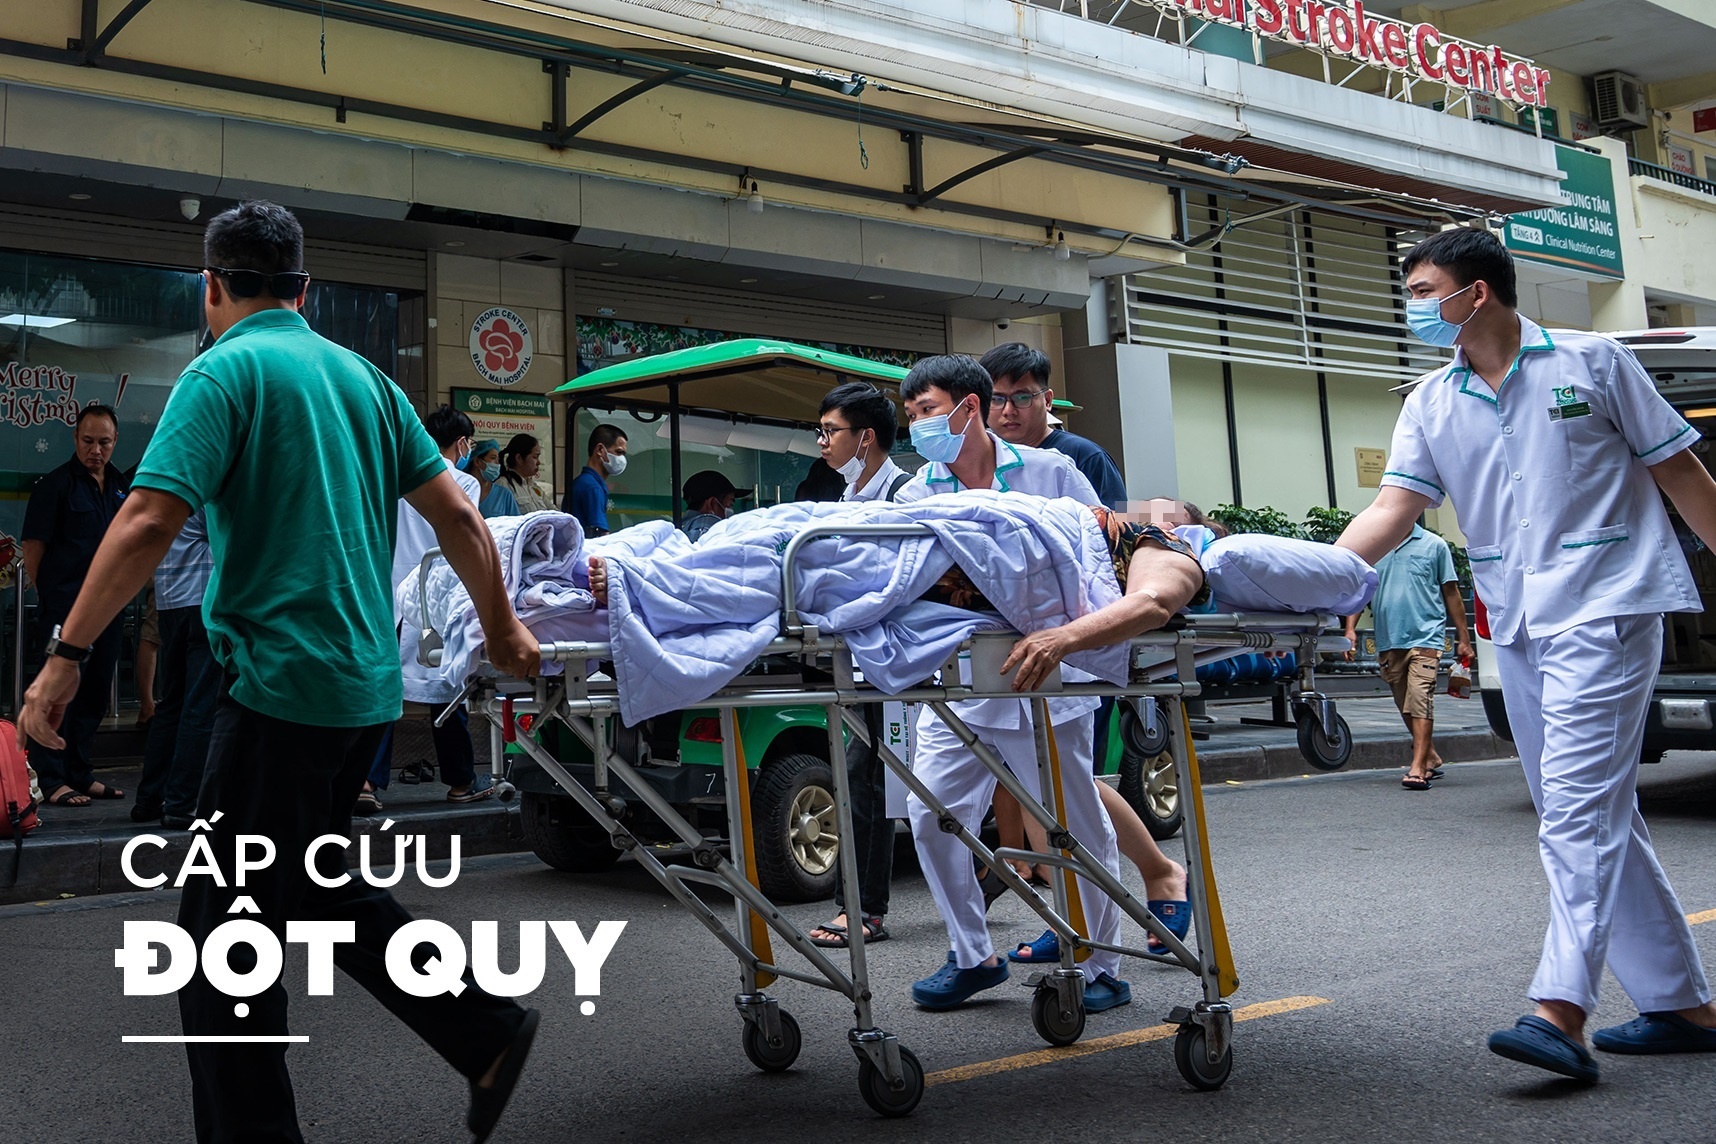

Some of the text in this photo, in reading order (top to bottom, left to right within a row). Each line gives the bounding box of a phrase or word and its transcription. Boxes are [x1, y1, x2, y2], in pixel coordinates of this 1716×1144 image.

[1254, 0, 1409, 68] Stroke
[1415, 22, 1550, 108] Center
[1591, 195, 1611, 215] TÂM
[1568, 211, 1588, 232] LÂM
[1590, 216, 1614, 237] SÀNG
[1545, 234, 1616, 259] Clinical Nutrition Center
[473, 309, 529, 336] STROKE CENTER
[472, 353, 532, 385] BACH MAI HOSPITAL
[0, 361, 78, 405] Merry
[501, 420, 519, 431] BỆNH
[519, 421, 535, 432] VIỆN
[890, 722, 901, 745] TCI
[705, 772, 716, 794] 7
